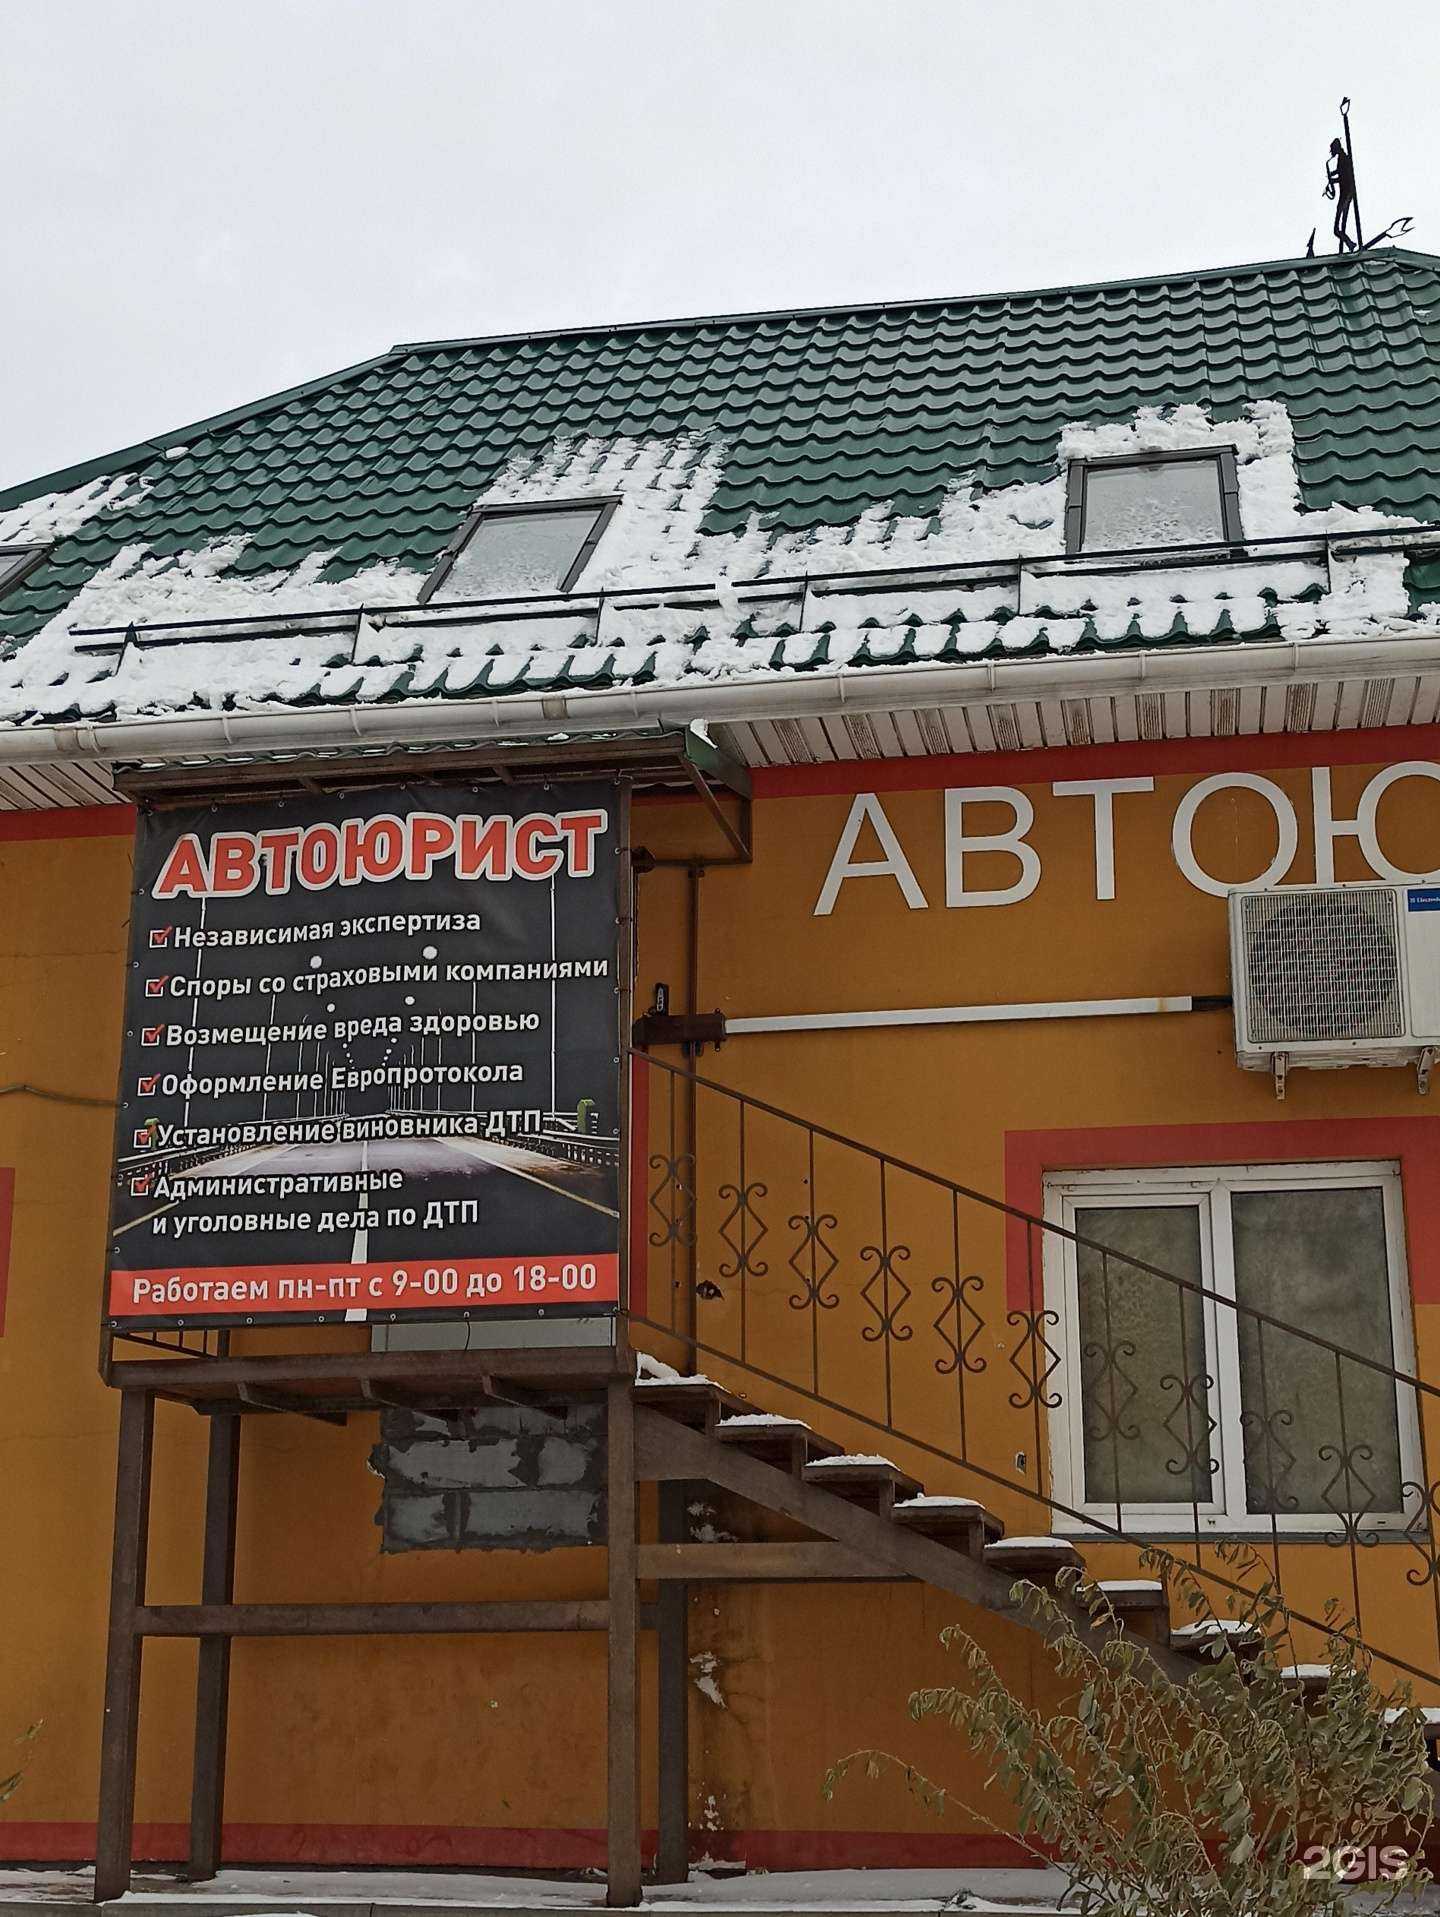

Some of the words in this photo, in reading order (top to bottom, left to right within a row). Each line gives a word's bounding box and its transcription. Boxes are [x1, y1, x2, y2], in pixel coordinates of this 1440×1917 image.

[152, 809, 608, 899] АВТОЮРИСТ
[174, 922, 334, 948] Независимая
[340, 913, 481, 937] экспертиза
[170, 977, 251, 999] Споры
[259, 978, 286, 994] со
[293, 964, 438, 994] страховыми
[446, 960, 608, 982] компаниями
[167, 1021, 327, 1047] Возмещение
[334, 1014, 402, 1039] вреда
[410, 1013, 540, 1036] здоровью
[162, 1072, 323, 1098] Оформление
[332, 1065, 523, 1091] Европротокола
[157, 1120, 335, 1147] Установление
[341, 1116, 478, 1140] виновника
[486, 1109, 541, 1136] ДТП
[154, 1172, 403, 1201] Административные
[152, 1218, 167, 1234] и
[173, 1212, 311, 1239] уголовные
[317, 1209, 379, 1232] дела
[386, 1207, 415, 1227] по
[423, 1199, 478, 1229] ДТП
[132, 1276, 268, 1304] Работаем
[278, 1276, 361, 1299] пн-пт
[369, 1277, 382, 1296] с
[392, 1269, 458, 1296] 9-00
[466, 1272, 501, 1298] до
[513, 1264, 596, 1292] 18-00
